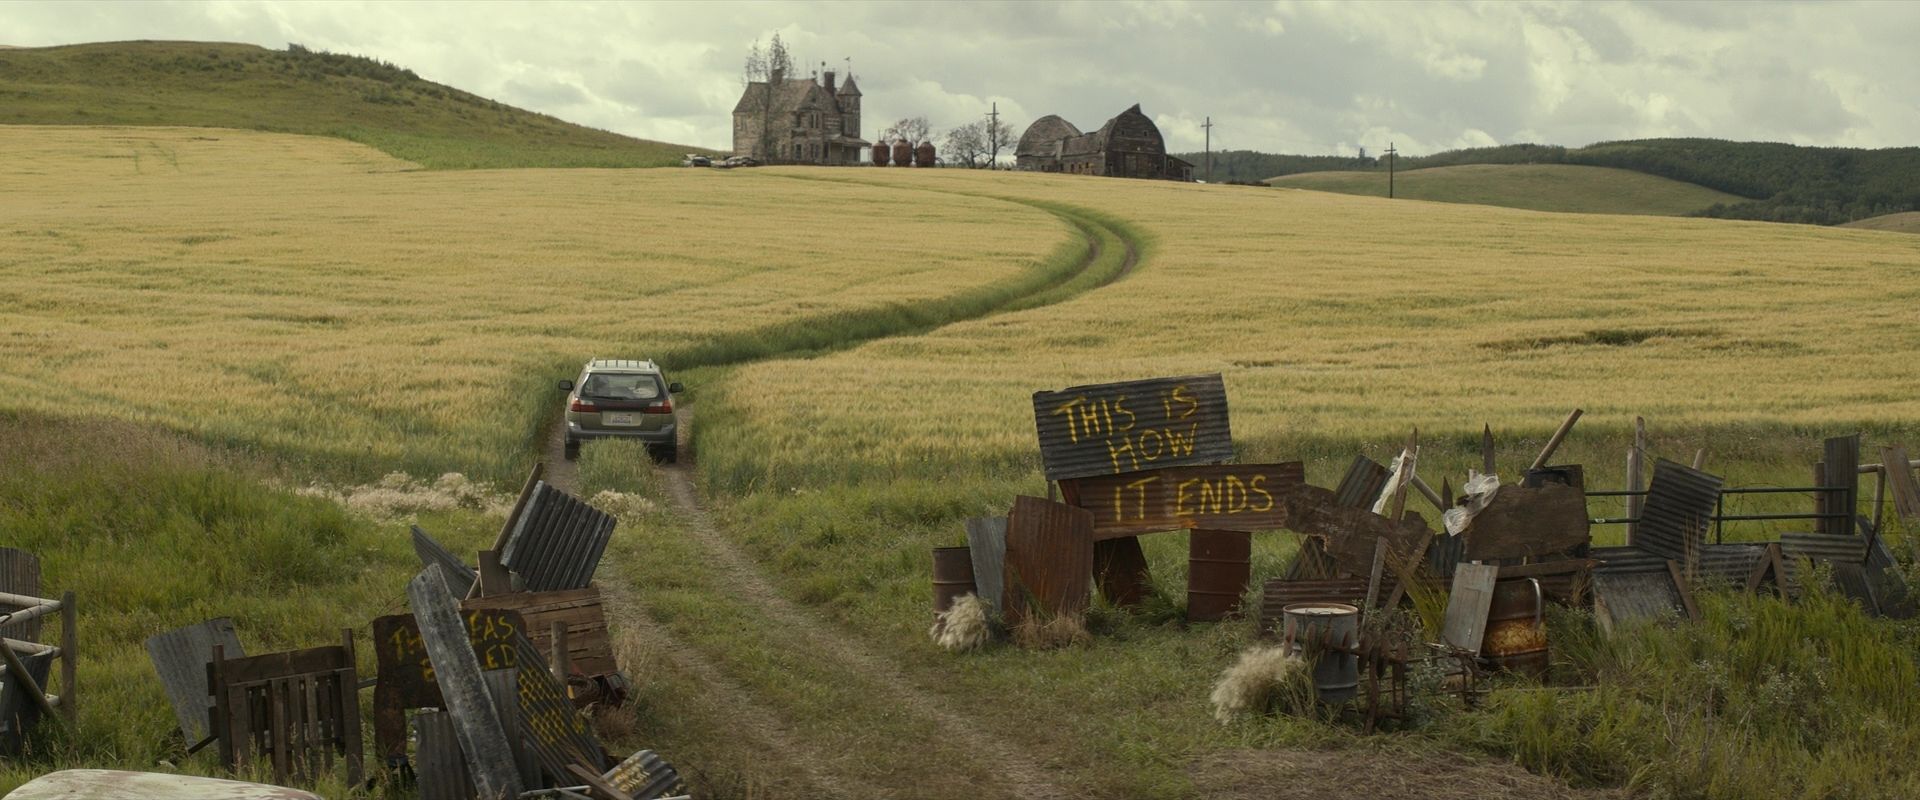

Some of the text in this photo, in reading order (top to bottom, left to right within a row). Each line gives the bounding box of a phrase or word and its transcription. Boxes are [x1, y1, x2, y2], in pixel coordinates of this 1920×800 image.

[1051, 394, 1135, 444] THIS
[1106, 422, 1198, 474] HOW
[1116, 475, 1275, 522] IT ENDS
[469, 610, 517, 643] EAS
[484, 643, 517, 668] ED
